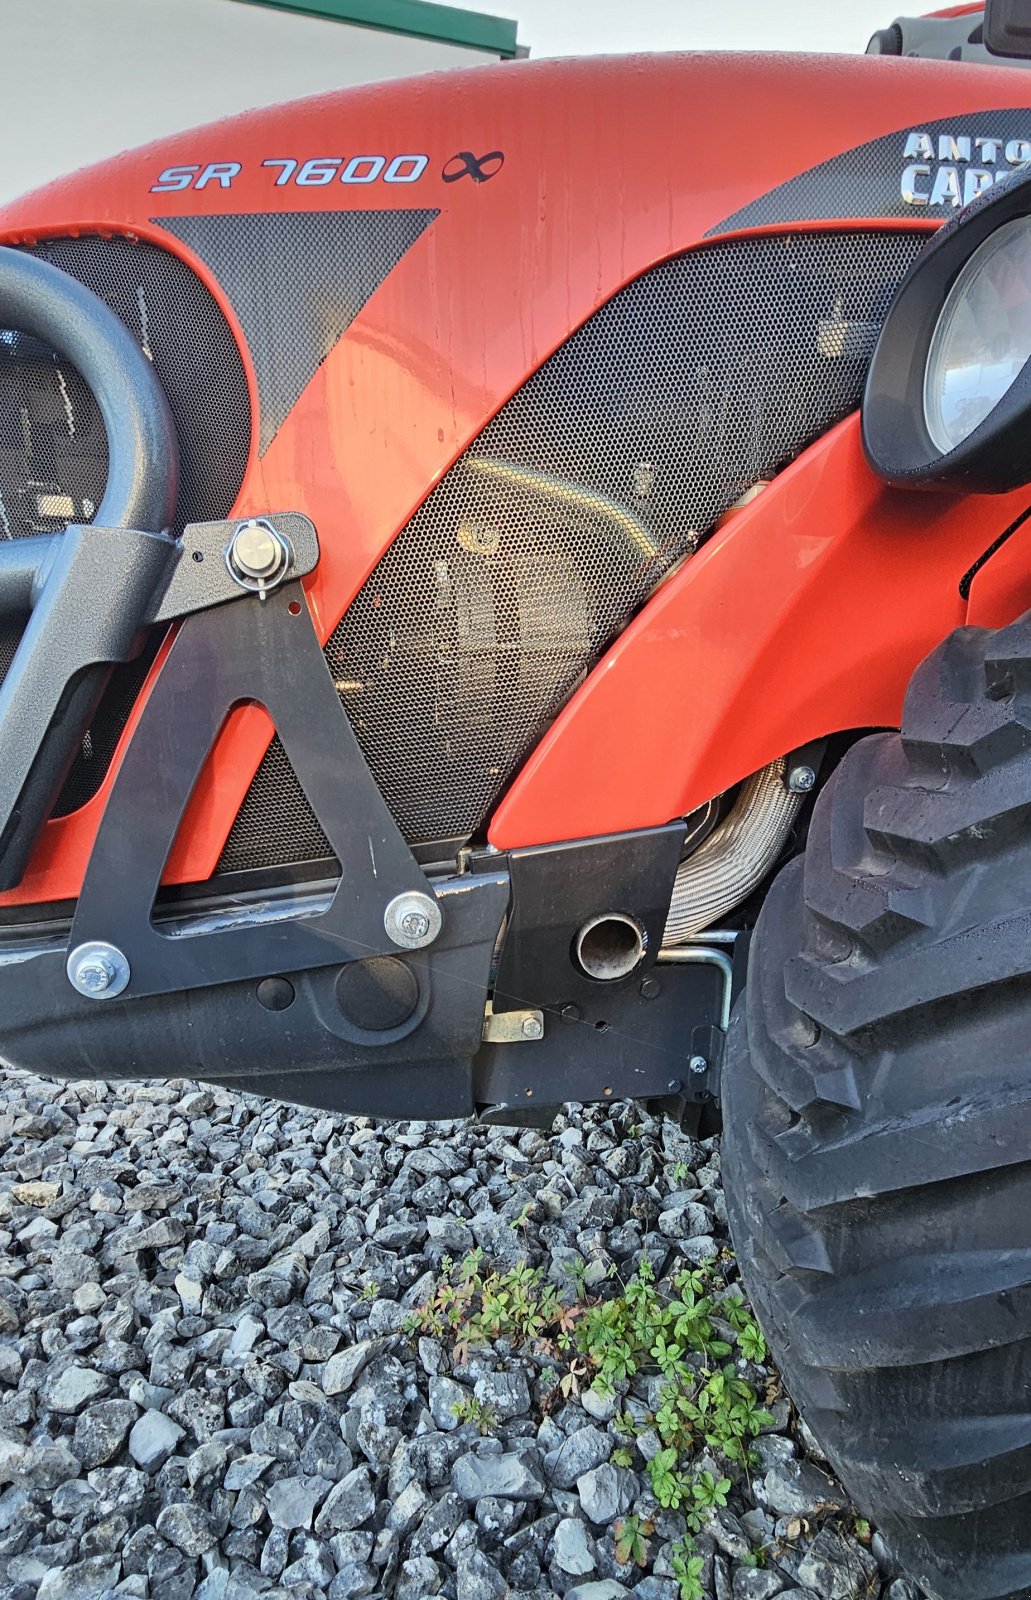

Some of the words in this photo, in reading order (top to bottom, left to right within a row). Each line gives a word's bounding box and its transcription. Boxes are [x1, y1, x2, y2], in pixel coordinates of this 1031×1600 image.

[903, 132, 1031, 164] ANTO
[150, 161, 242, 193] SR
[261, 154, 429, 187] 7600
[901, 164, 1011, 208] CAR
